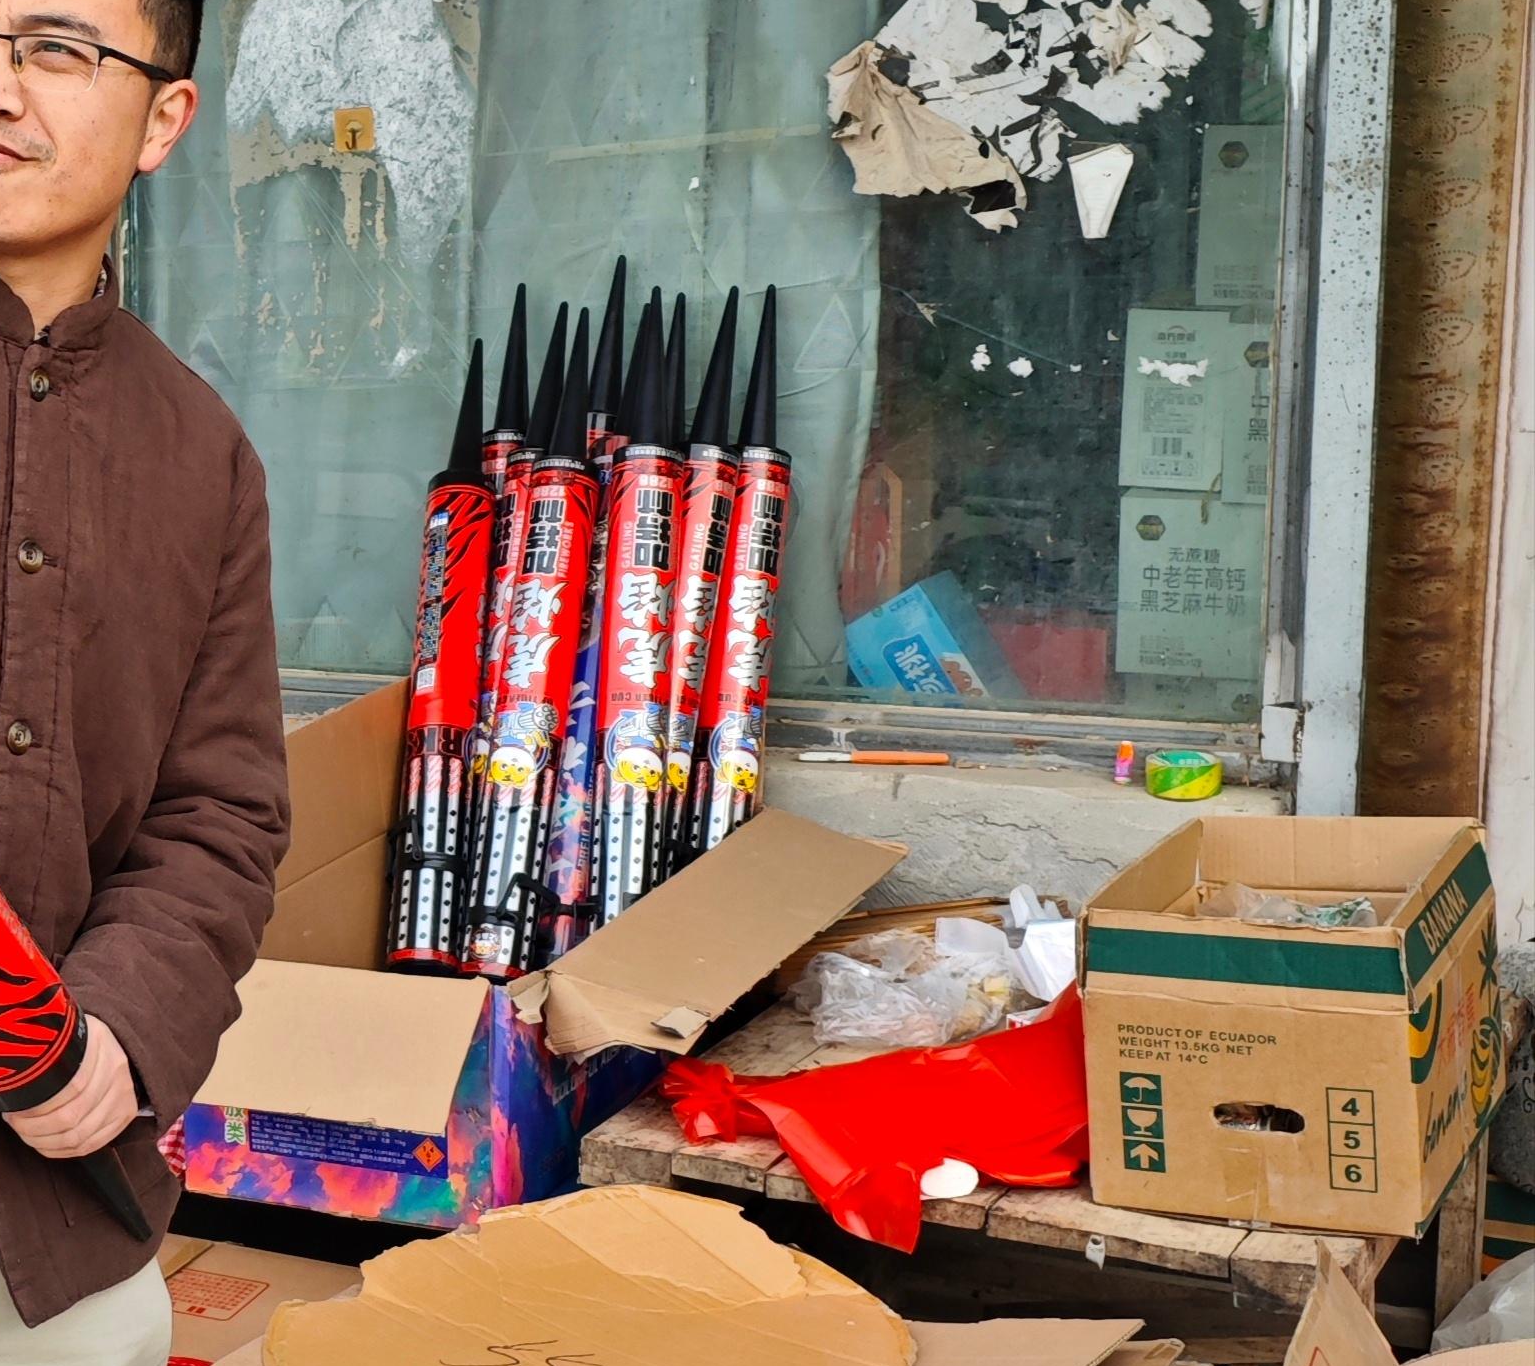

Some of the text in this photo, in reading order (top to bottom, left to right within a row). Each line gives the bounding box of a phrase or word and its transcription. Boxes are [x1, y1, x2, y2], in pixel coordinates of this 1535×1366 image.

[522, 498, 567, 576] 加特林
[621, 521, 634, 570] GATLING
[633, 487, 675, 572] 加特林
[689, 521, 705, 571] GATLING
[734, 522, 748, 571] GATLING
[746, 490, 786, 573] 加特林
[1168, 547, 1221, 564] 无蔗糖
[1142, 564, 1247, 592] 中老年高钙
[1139, 589, 1246, 617] 黑芝麻牛奶
[502, 579, 569, 690] 虎焰
[617, 571, 676, 690] 虎焰
[1417, 878, 1469, 957] BANANA
[1117, 1024, 1277, 1046] PRODUCT OF ECUADOR
[1118, 1036, 1253, 1057] WEIGHT 13.5KG NET
[1119, 1048, 1155, 1060] KEEP
[1156, 1052, 1171, 1062] AT
[1341, 1097, 1360, 1118] 4
[1344, 1131, 1361, 1151] 5
[1345, 1164, 1362, 1185] 6
